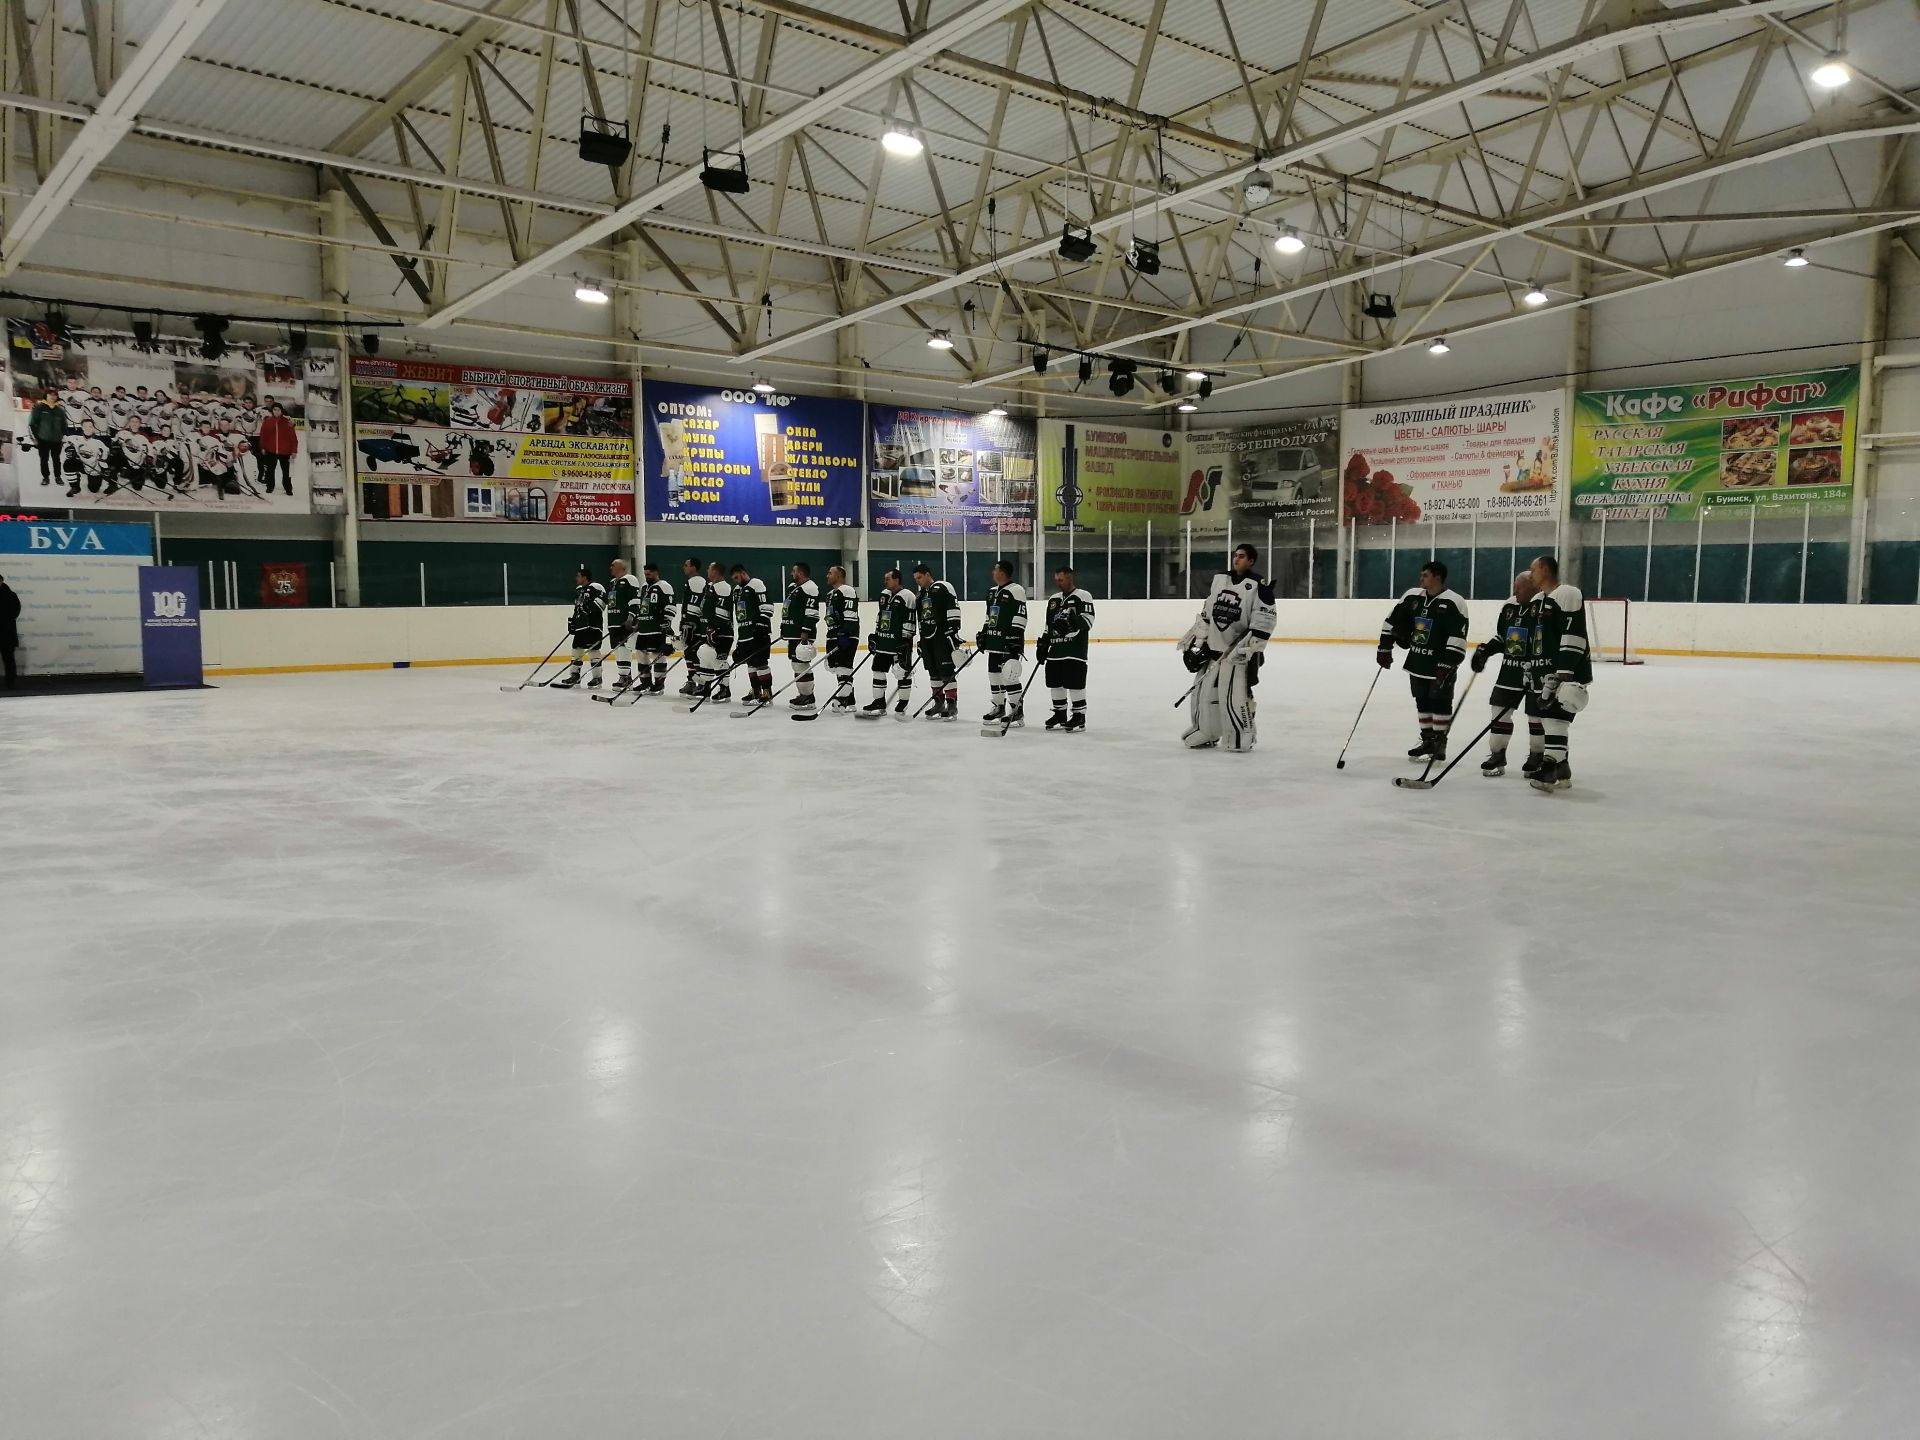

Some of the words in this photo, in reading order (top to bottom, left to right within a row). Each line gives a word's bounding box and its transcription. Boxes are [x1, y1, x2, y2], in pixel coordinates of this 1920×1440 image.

[402, 365, 455, 382] ЖЕВИТ
[462, 370, 506, 385] ВЫБИРАЙ
[508, 375, 567, 390] СПОРТИВНЫЙ
[568, 380, 595, 392] ОБРАЗ
[597, 382, 629, 395] ЖИЗНИ
[720, 390, 757, 405] ООО
[1606, 391, 1684, 419] Кафе
[1692, 381, 1827, 411] «Рифат»
[658, 402, 713, 418] ОПТОМ:
[1369, 405, 1456, 426] «ВОЗДУШНЫЙ
[1459, 399, 1536, 419] ПРАЗДНИК»
[682, 418, 720, 431] САХАР
[1394, 428, 1425, 440] ЦВЕТЫ
[1476, 421, 1507, 433] ШАРЫ
[786, 426, 817, 438] ОКНА
[1593, 426, 1665, 441] РУССКАЯ
[529, 439, 566, 449] АРЕНДА
[568, 441, 630, 451] ЭКСКАВАТОРА
[682, 433, 716, 445] МУКА
[786, 440, 823, 452] ДВЕРИ
[1597, 441, 1686, 457] ТАТАРСКАЯ
[682, 447, 725, 459] КРУПЫ
[682, 461, 751, 475] МАКАРОНЫ
[811, 455, 857, 468] ЗАБОРЫ
[1604, 459, 1694, 474] УЗБЕКСКАЯ
[786, 467, 828, 479] СТЕКЛО
[560, 481, 590, 490] КРЕДИТ
[682, 475, 725, 488] МАСЛО
[786, 481, 821, 492] ПЕТЛИ
[1437, 479, 1463, 489] ТКАНЬЮ
[1613, 477, 1668, 490] КУХНЯ
[682, 490, 720, 503] ВОДЫ
[786, 494, 824, 506] ЗАМКИ
[1277, 497, 1332, 508] федеральных
[1575, 494, 1627, 506] СВЕЖАЯ
[1627, 492, 1692, 504] ВЫПЕЧКА
[1716, 495, 1752, 505] Буинск,
[1755, 494, 1769, 503] ул.
[1772, 491, 1820, 501] Вахитова,
[566, 514, 632, 522] 8-9600-400-630
[742, 513, 750, 523] 4
[1274, 510, 1304, 519] трассах
[1305, 508, 1335, 517] России
[776, 516, 802, 526] тел.
[805, 516, 852, 527] 33-8-55
[28, 526, 105, 550] БУА
[844, 600, 854, 609] 70
[1017, 604, 1026, 615] 15
[1084, 604, 1092, 613] 11
[1566, 616, 1573, 631] 7
